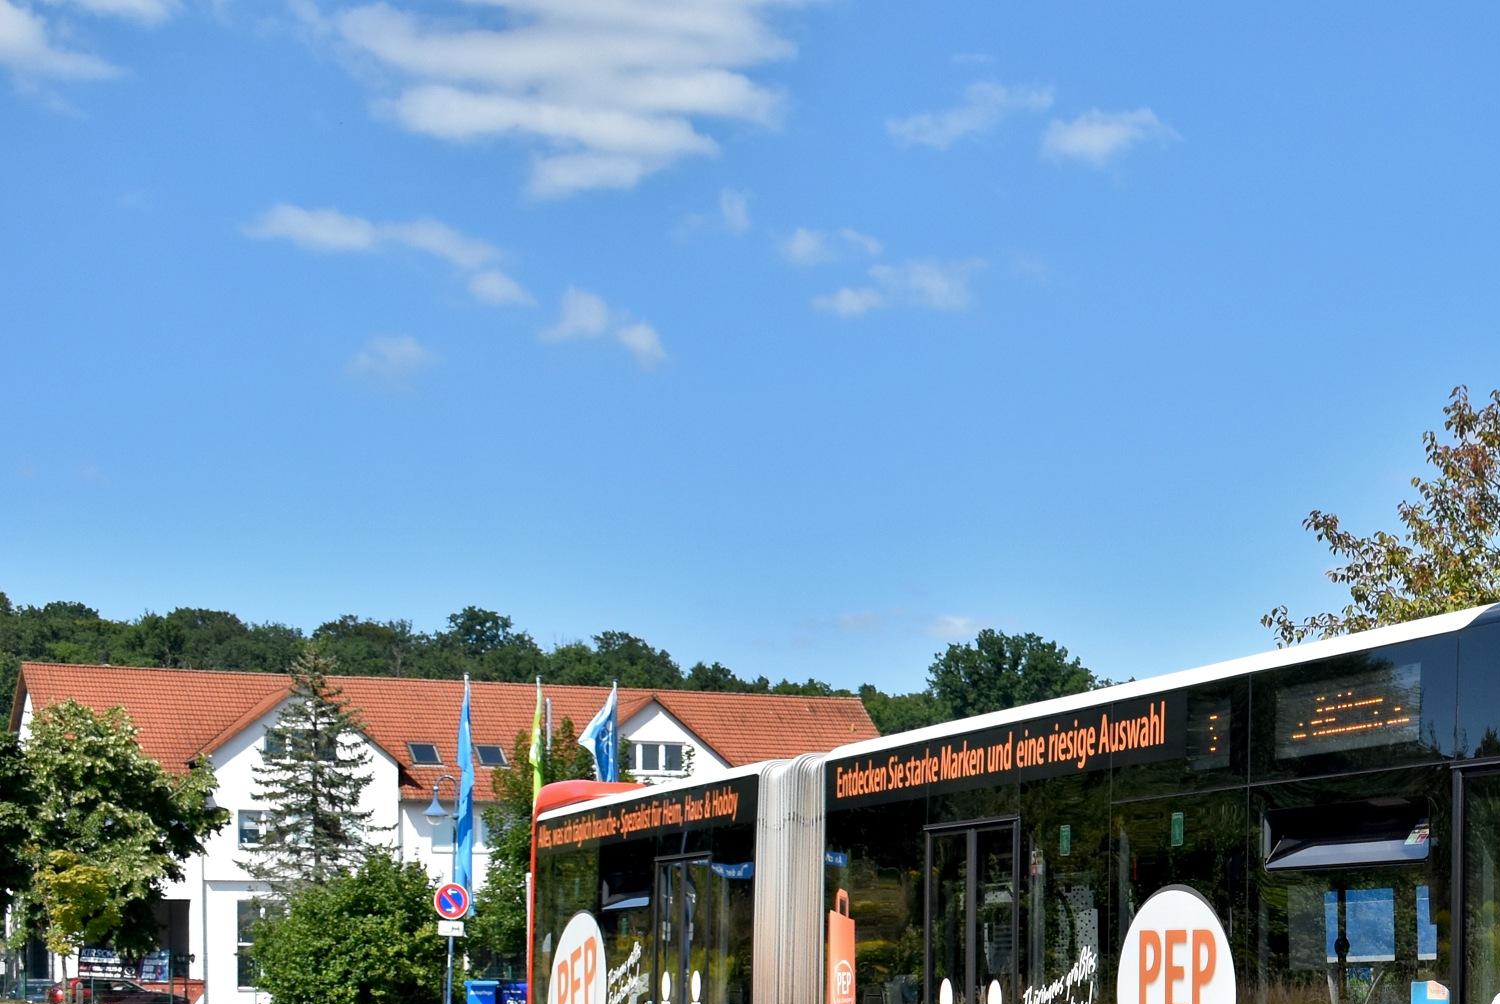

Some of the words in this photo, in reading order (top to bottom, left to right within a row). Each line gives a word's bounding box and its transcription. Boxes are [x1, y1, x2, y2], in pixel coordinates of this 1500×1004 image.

[837, 759, 887, 798] Entdecken
[888, 755, 903, 790] Sie
[905, 748, 938, 787] starke
[940, 740, 985, 781] Marken
[987, 731, 1013, 774] und
[1016, 729, 1045, 768] eine
[1048, 719, 1096, 769] riesige
[1098, 701, 1166, 754] Auswahl
[620, 804, 651, 838] Spezialist
[651, 801, 662, 828] für
[662, 797, 683, 827] Heim,
[684, 794, 703, 821] Haus
[704, 791, 711, 818] &
[712, 786, 739, 822] Hobby
[836, 971, 852, 995] PEP
[1065, 945, 1097, 1002] größtes
